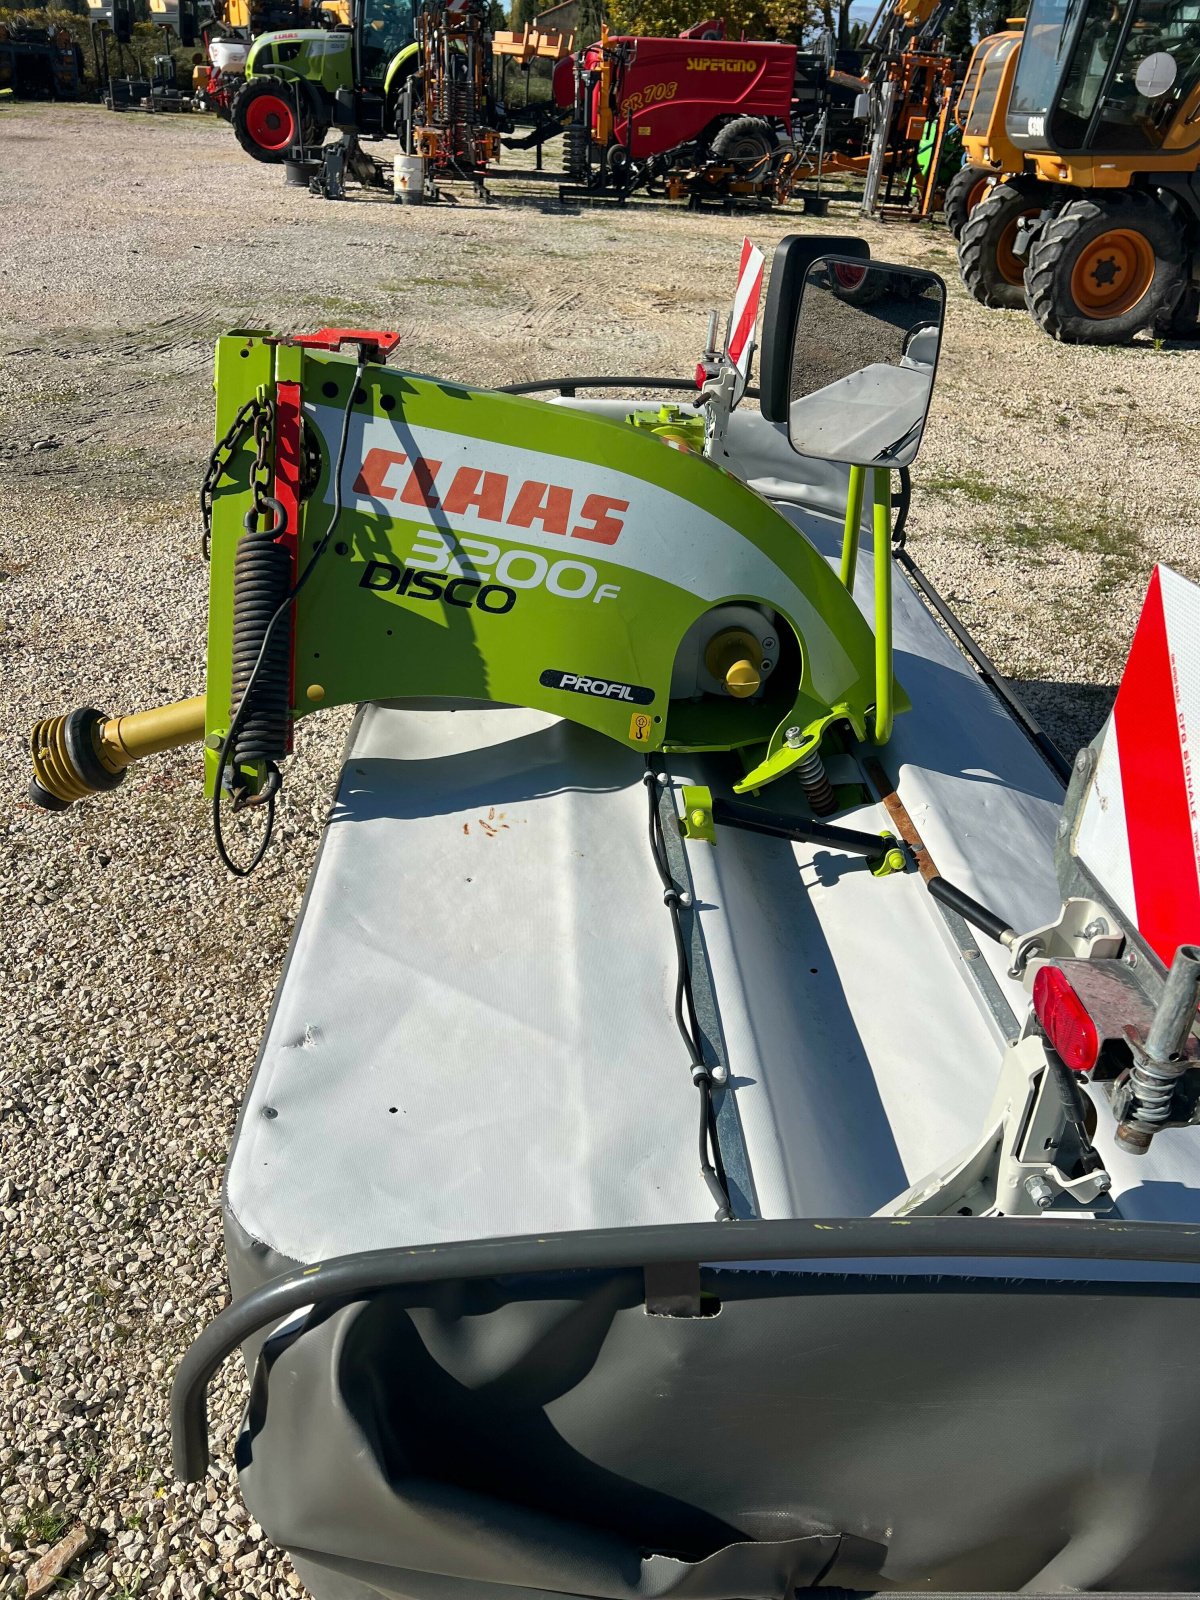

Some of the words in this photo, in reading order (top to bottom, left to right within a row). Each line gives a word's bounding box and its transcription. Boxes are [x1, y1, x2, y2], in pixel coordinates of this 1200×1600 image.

[686, 57, 757, 73] SUPERTINO
[621, 92, 644, 118] SR
[643, 81, 678, 103] 708
[352, 447, 630, 545] CLAAS
[358, 560, 517, 615] DISCO
[559, 674, 634, 701] PROFIL
